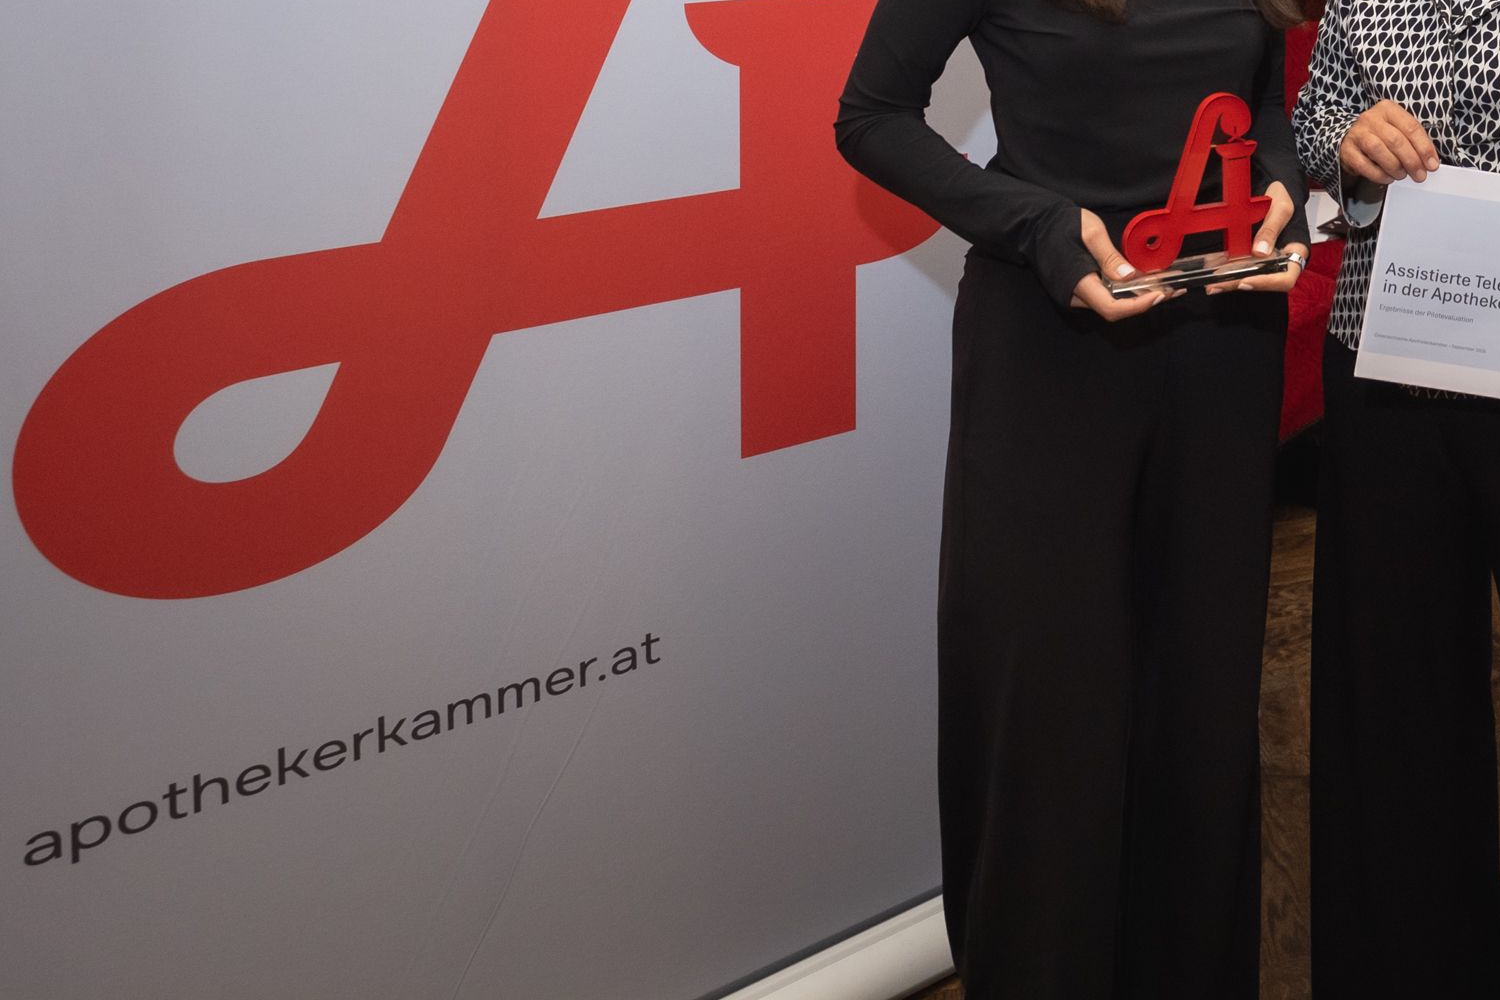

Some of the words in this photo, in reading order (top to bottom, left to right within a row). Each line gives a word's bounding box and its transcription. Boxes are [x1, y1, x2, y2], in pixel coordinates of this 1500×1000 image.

[1386, 262, 1470, 286] Assistierte
[1383, 280, 1397, 294] in
[1402, 283, 1428, 298] der
[24, 633, 661, 866] apothekerkammer.at
